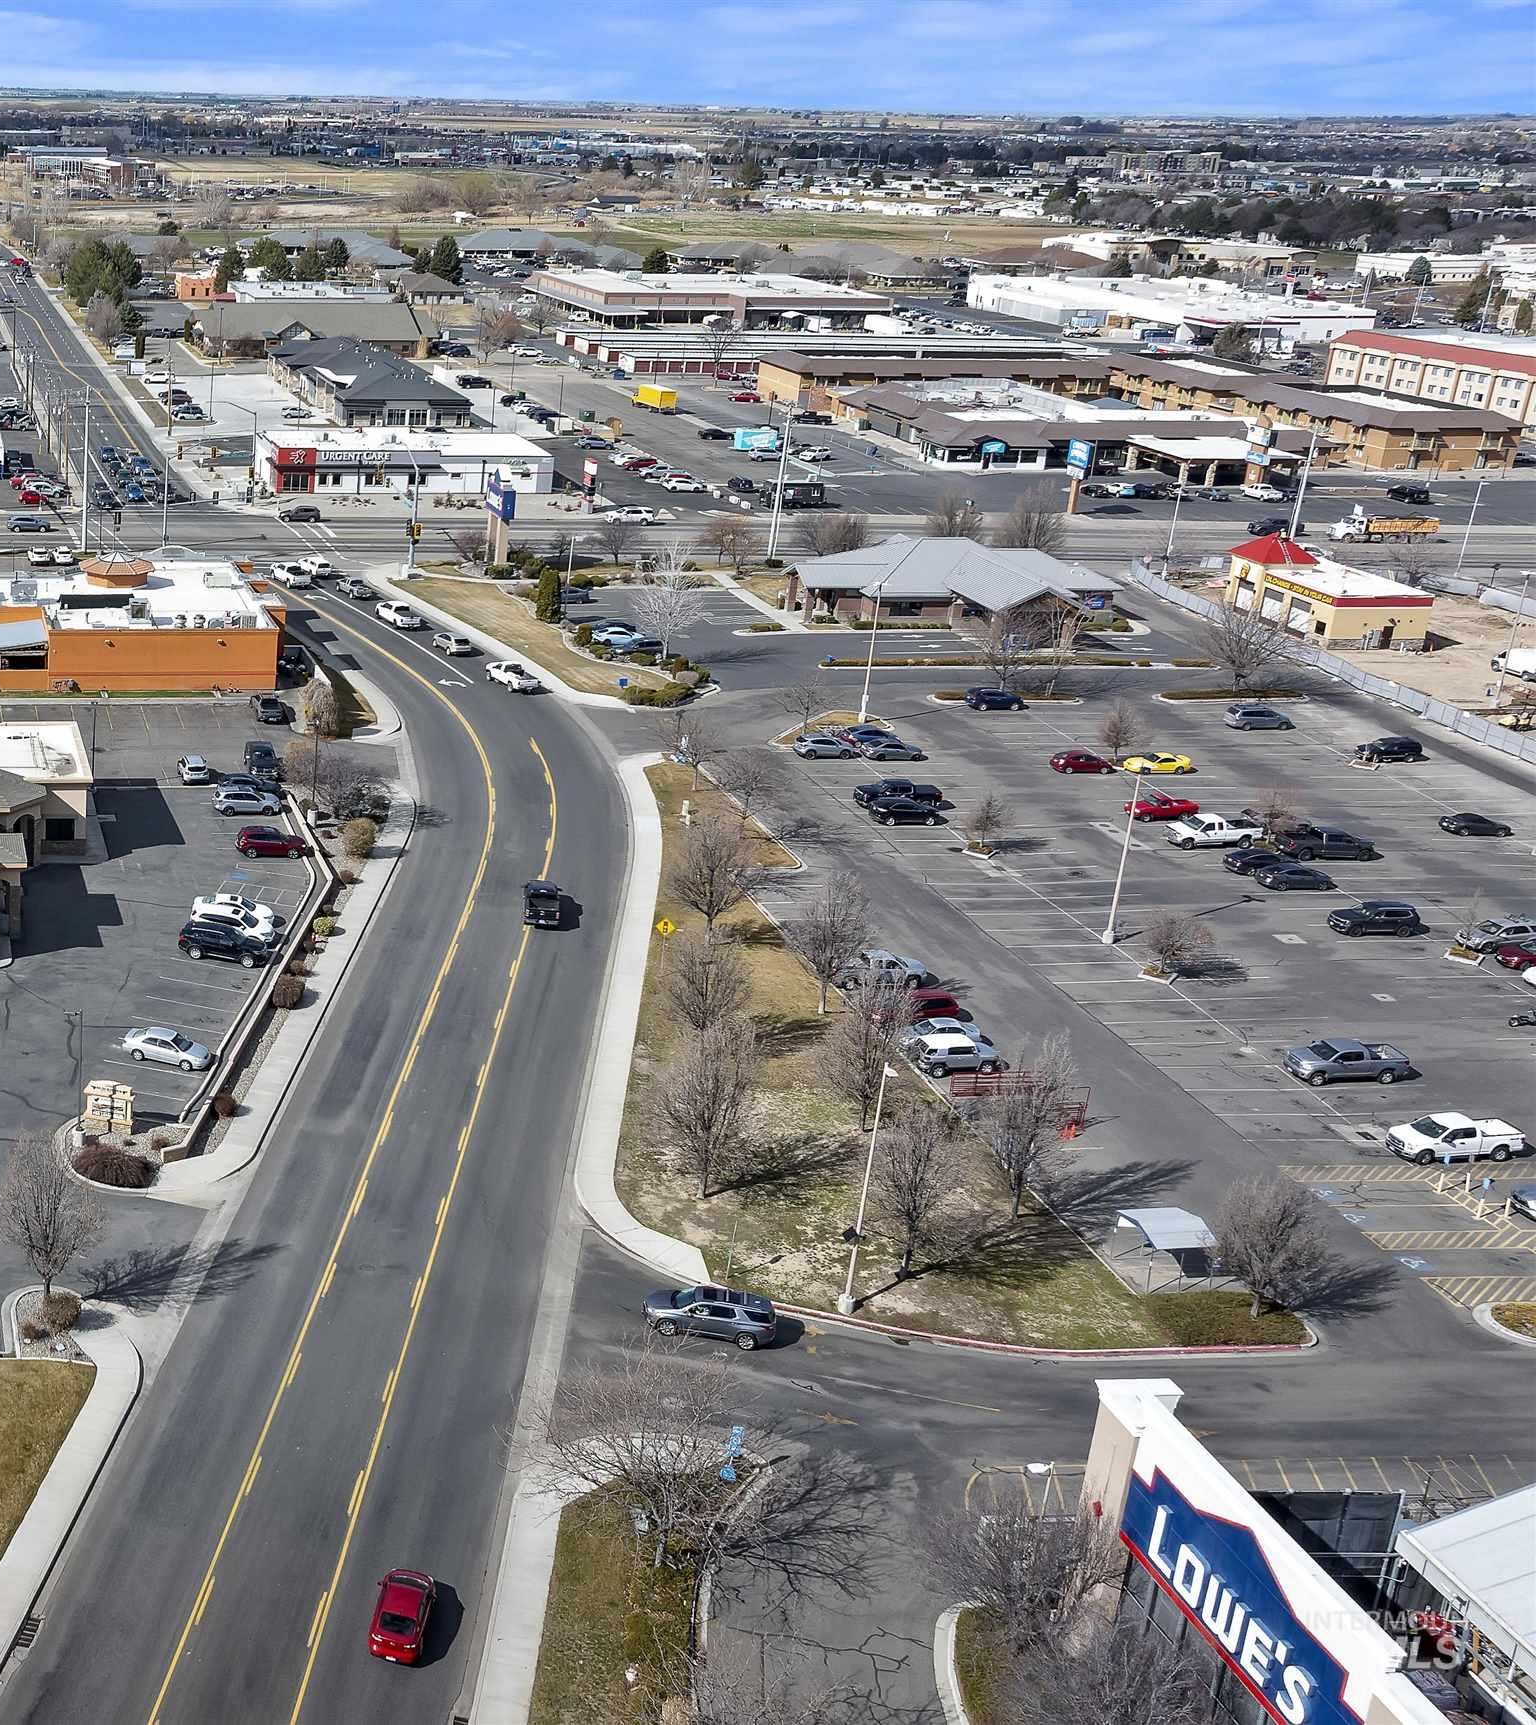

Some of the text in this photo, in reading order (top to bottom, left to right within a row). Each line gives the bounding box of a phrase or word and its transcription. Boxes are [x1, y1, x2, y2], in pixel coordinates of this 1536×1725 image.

[321, 451, 392, 461] URGENT CARE
[1148, 1505, 1313, 1724] LOWE'S
